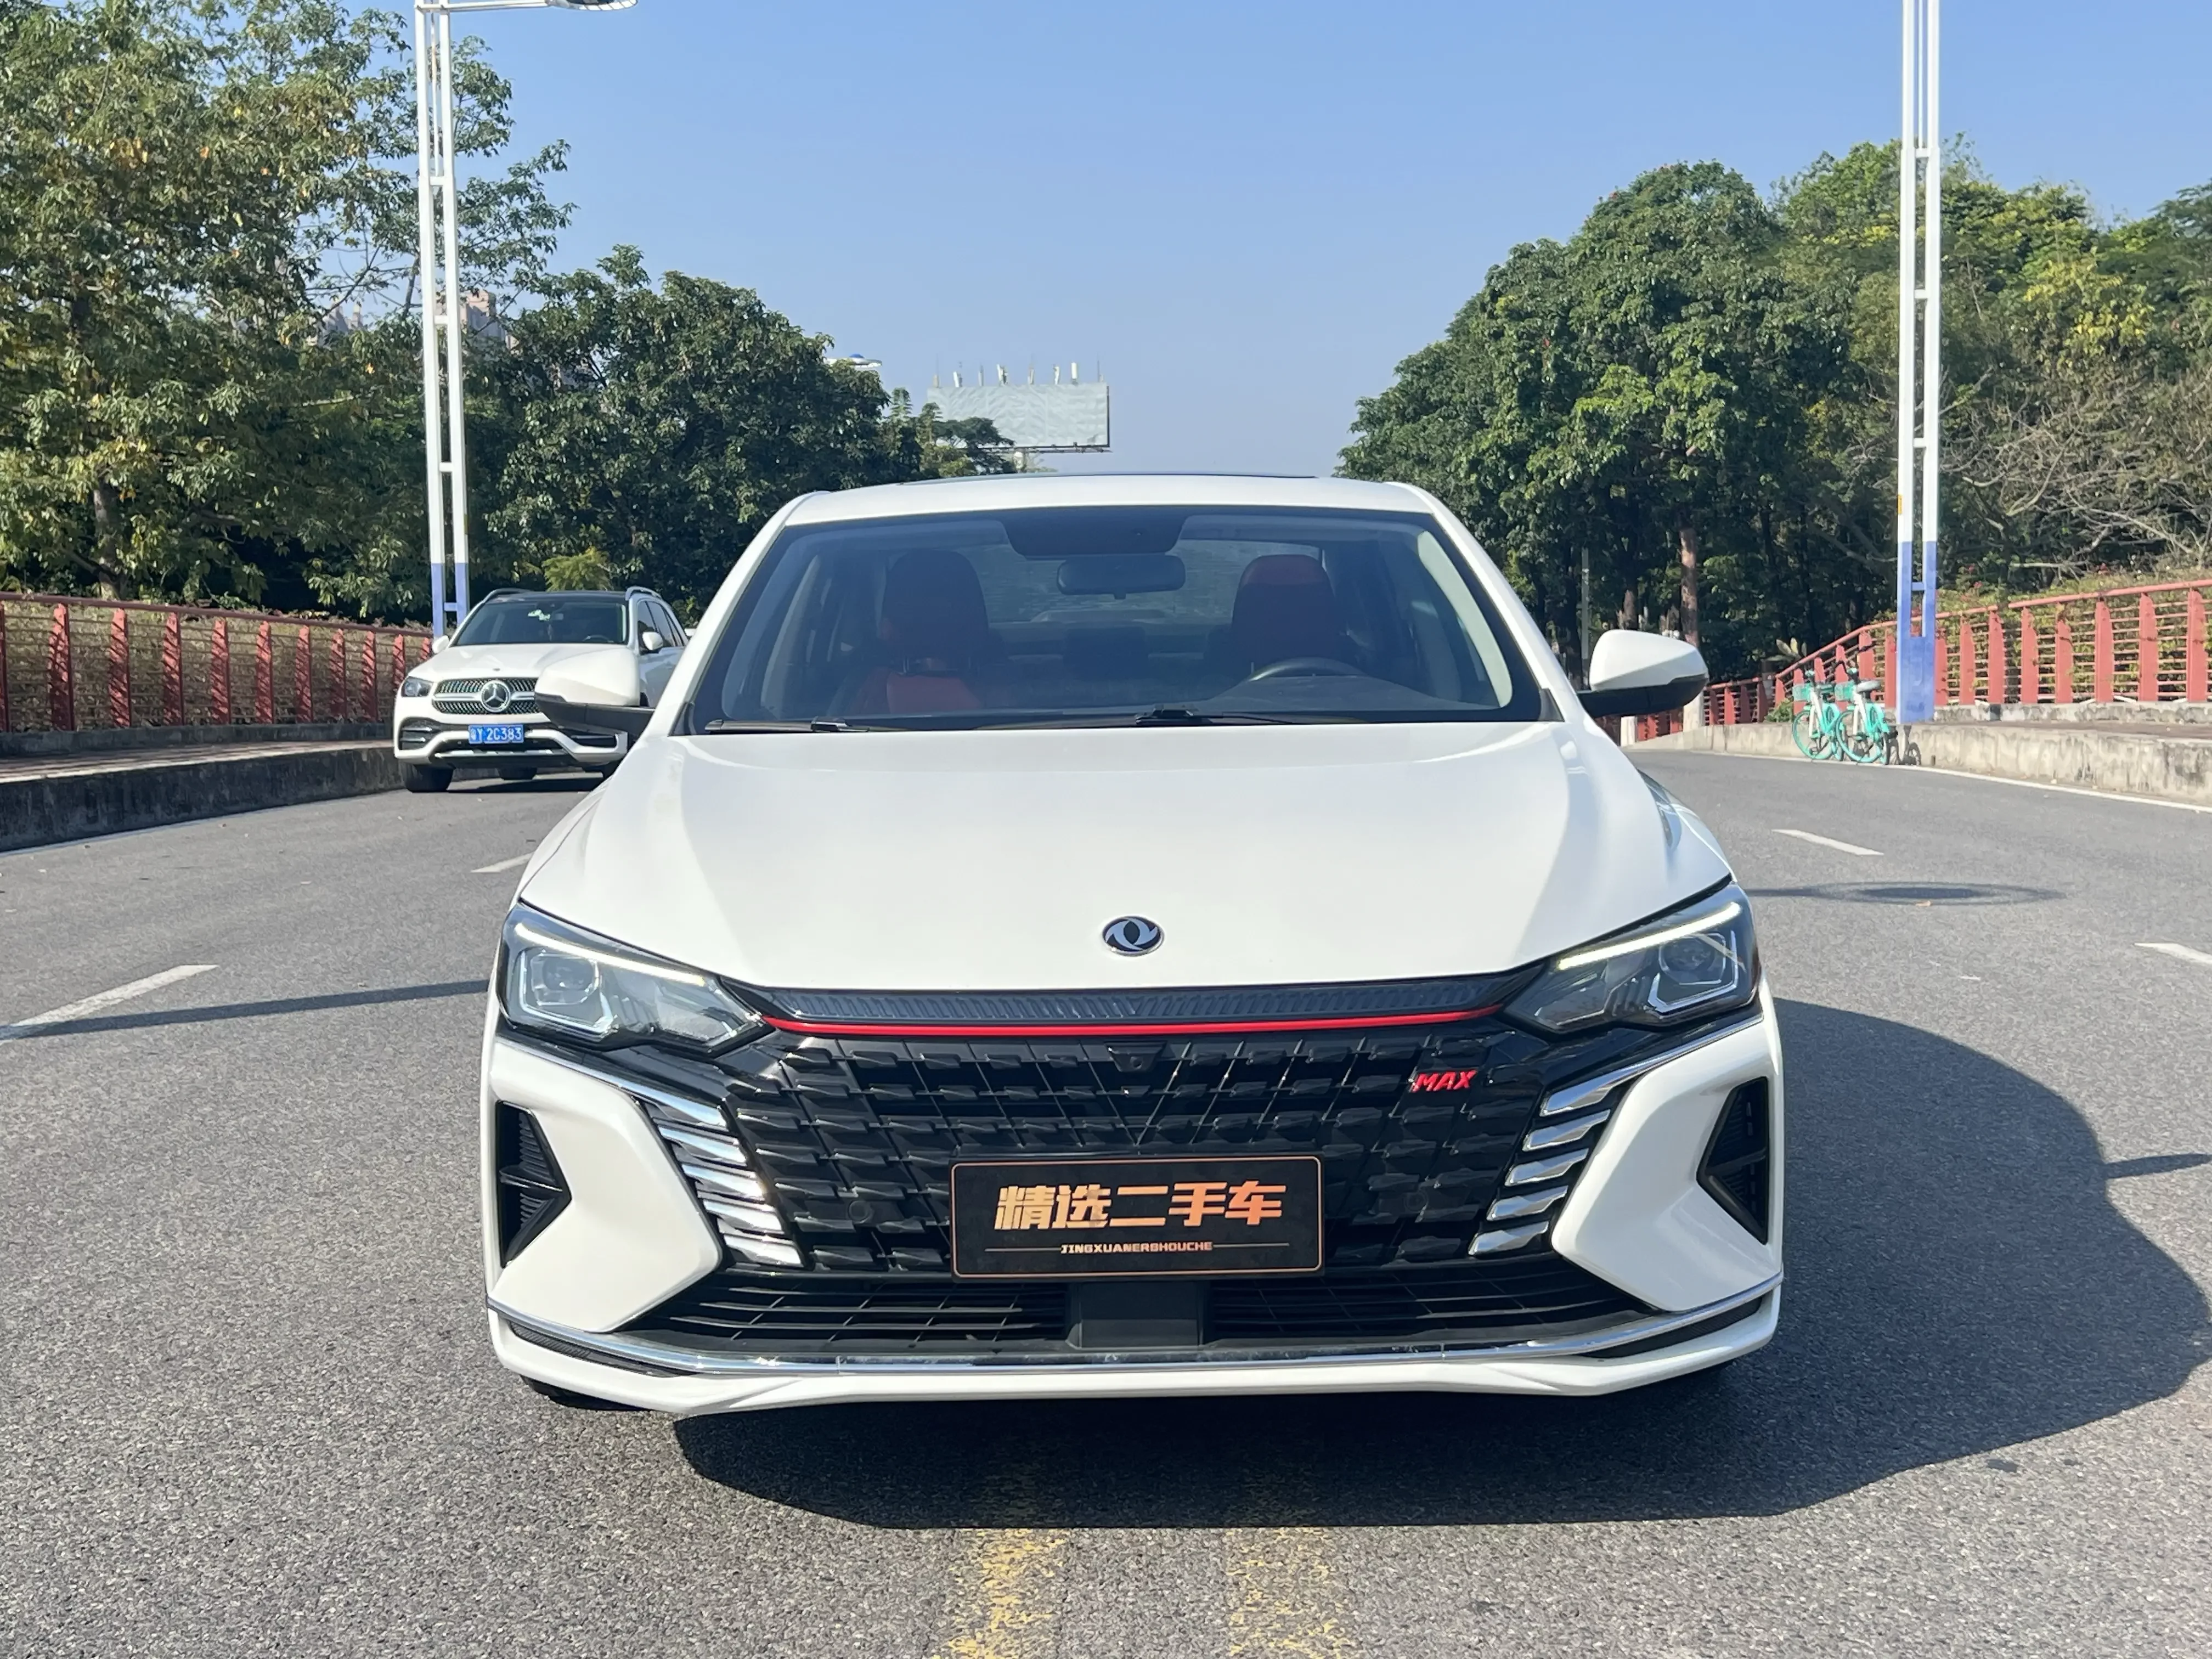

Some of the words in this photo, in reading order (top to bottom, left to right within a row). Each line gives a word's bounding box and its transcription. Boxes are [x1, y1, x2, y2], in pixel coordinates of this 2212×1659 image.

[1412, 1070, 1477, 1093] MAX
[994, 1181, 1286, 1230] 精选二手车
